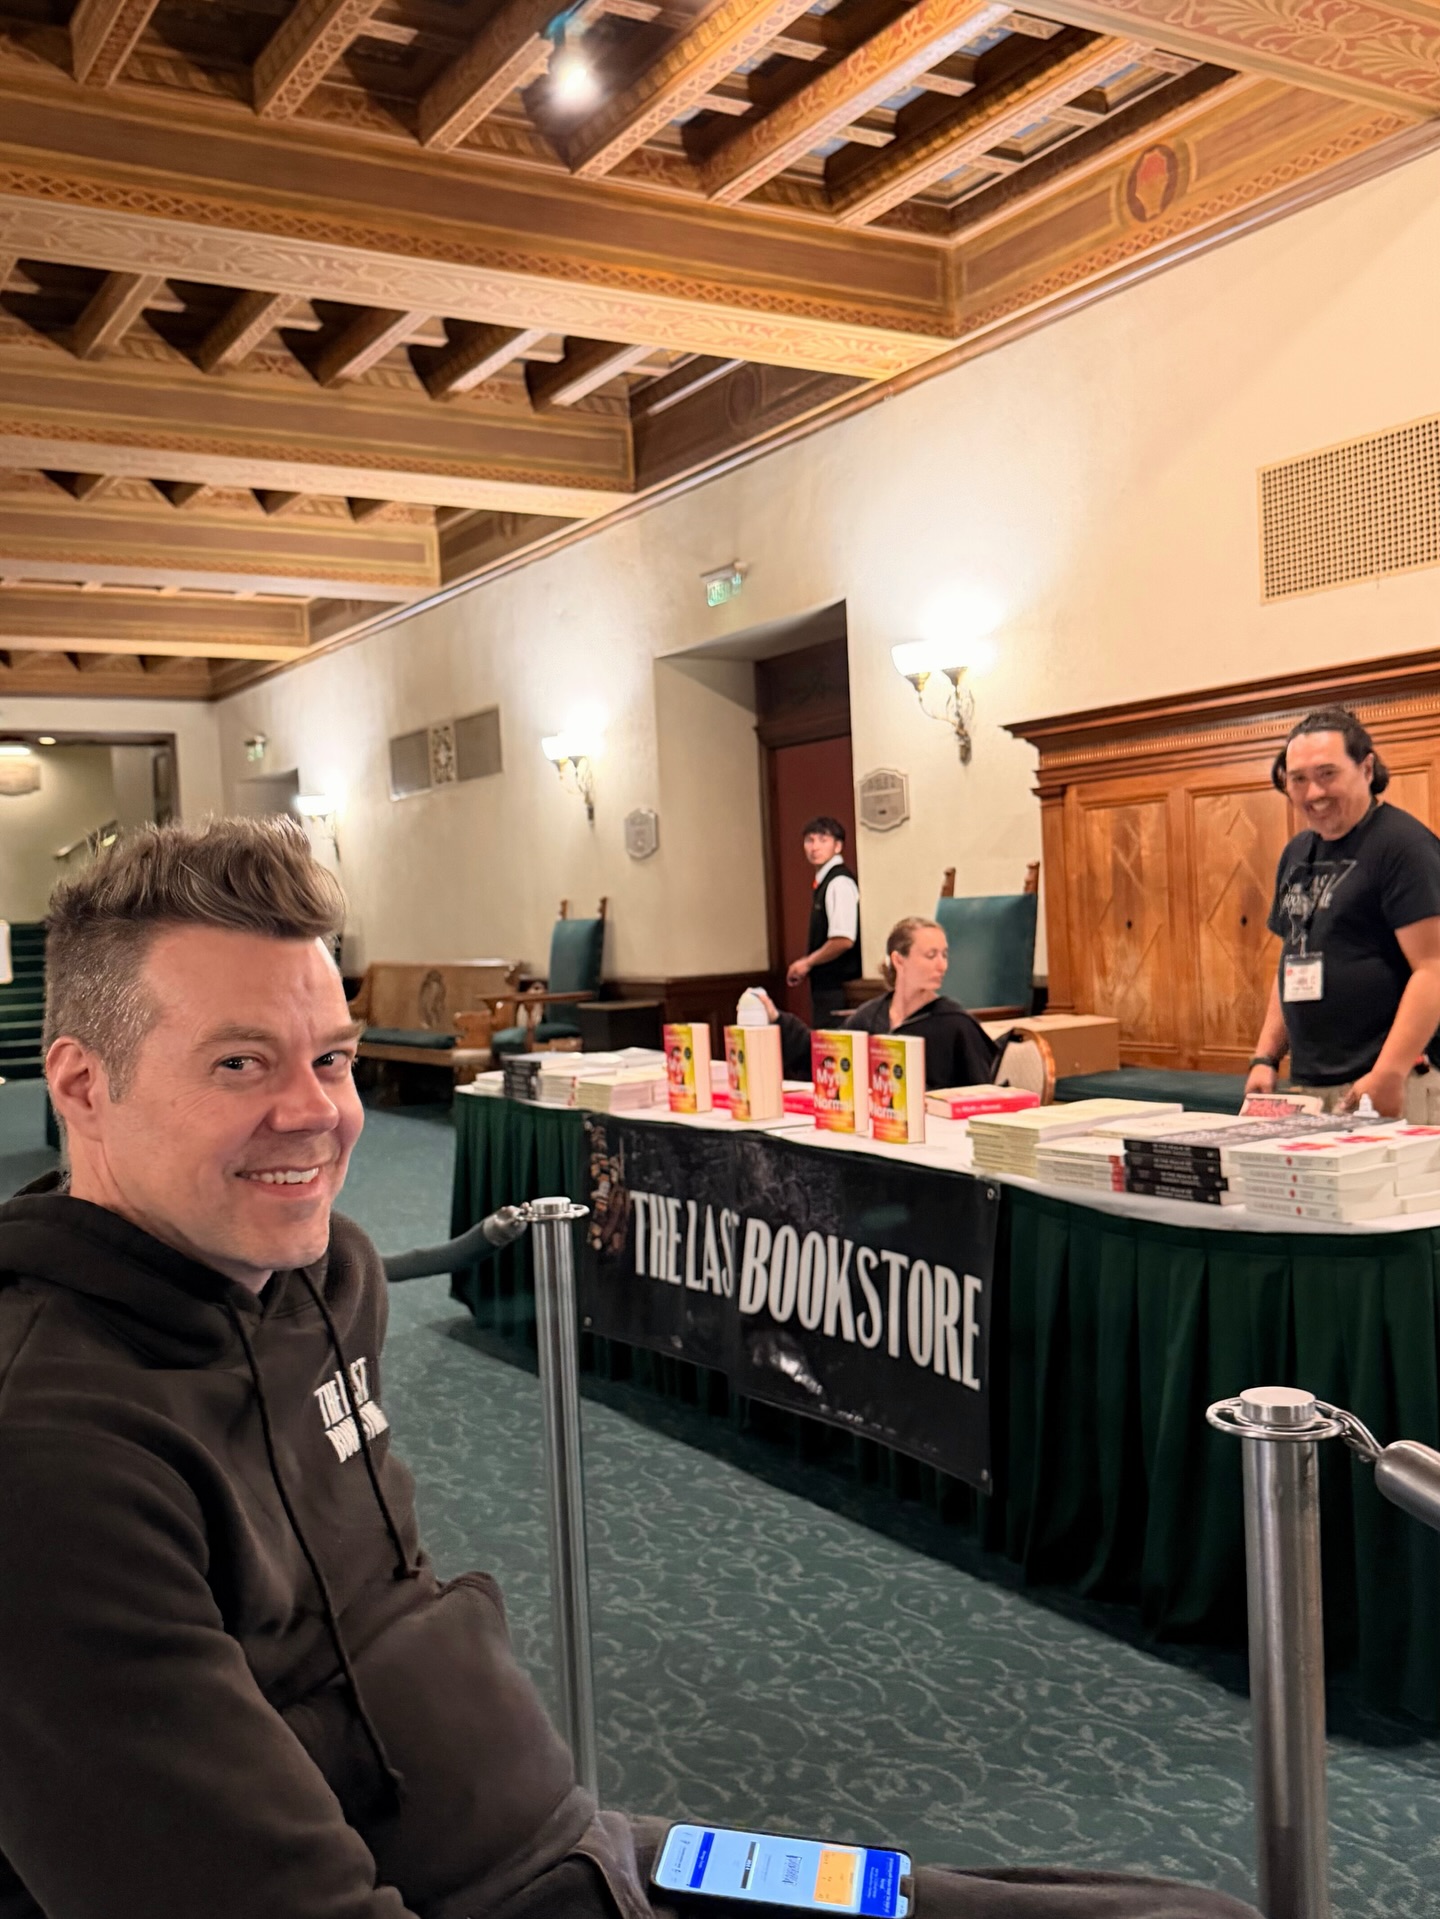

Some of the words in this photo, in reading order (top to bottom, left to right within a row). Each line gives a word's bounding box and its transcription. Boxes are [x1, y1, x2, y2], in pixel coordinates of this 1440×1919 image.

[628, 1189, 682, 1284] THE
[738, 1217, 983, 1392] BOOKSTORE
[313, 1379, 346, 1429] THE
[335, 1357, 369, 1416] LST
